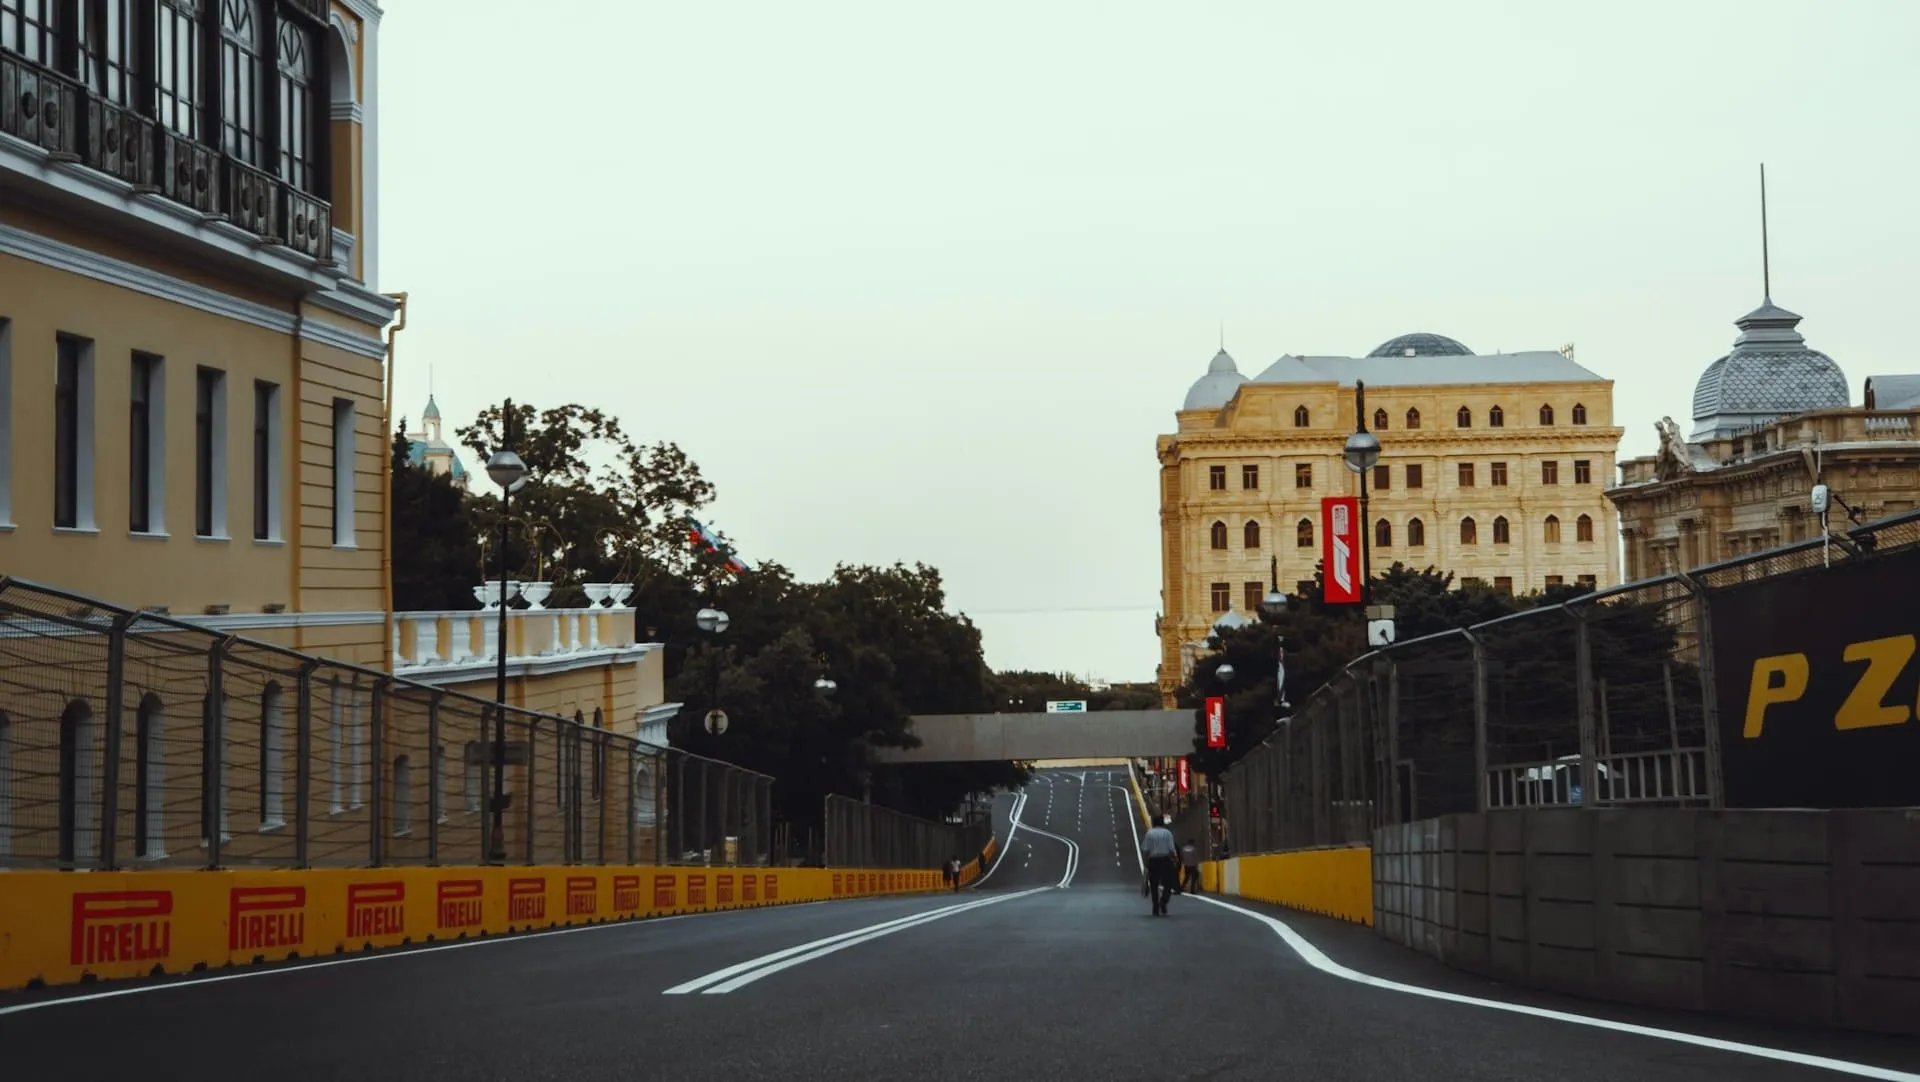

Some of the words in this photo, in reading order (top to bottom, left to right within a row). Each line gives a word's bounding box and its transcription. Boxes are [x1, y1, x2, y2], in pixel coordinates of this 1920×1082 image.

[1743, 652, 1810, 739] P
[1834, 633, 1920, 731] Z
[228, 886, 306, 951] PIRELLI
[346, 881, 405, 938] PIRELLI
[437, 879, 483, 929] PIRELLI
[508, 877, 545, 922] PIRELLI
[566, 876, 597, 915] PIRELLI
[613, 875, 639, 911] PIRELLI
[70, 890, 173, 966] PIRELLI
